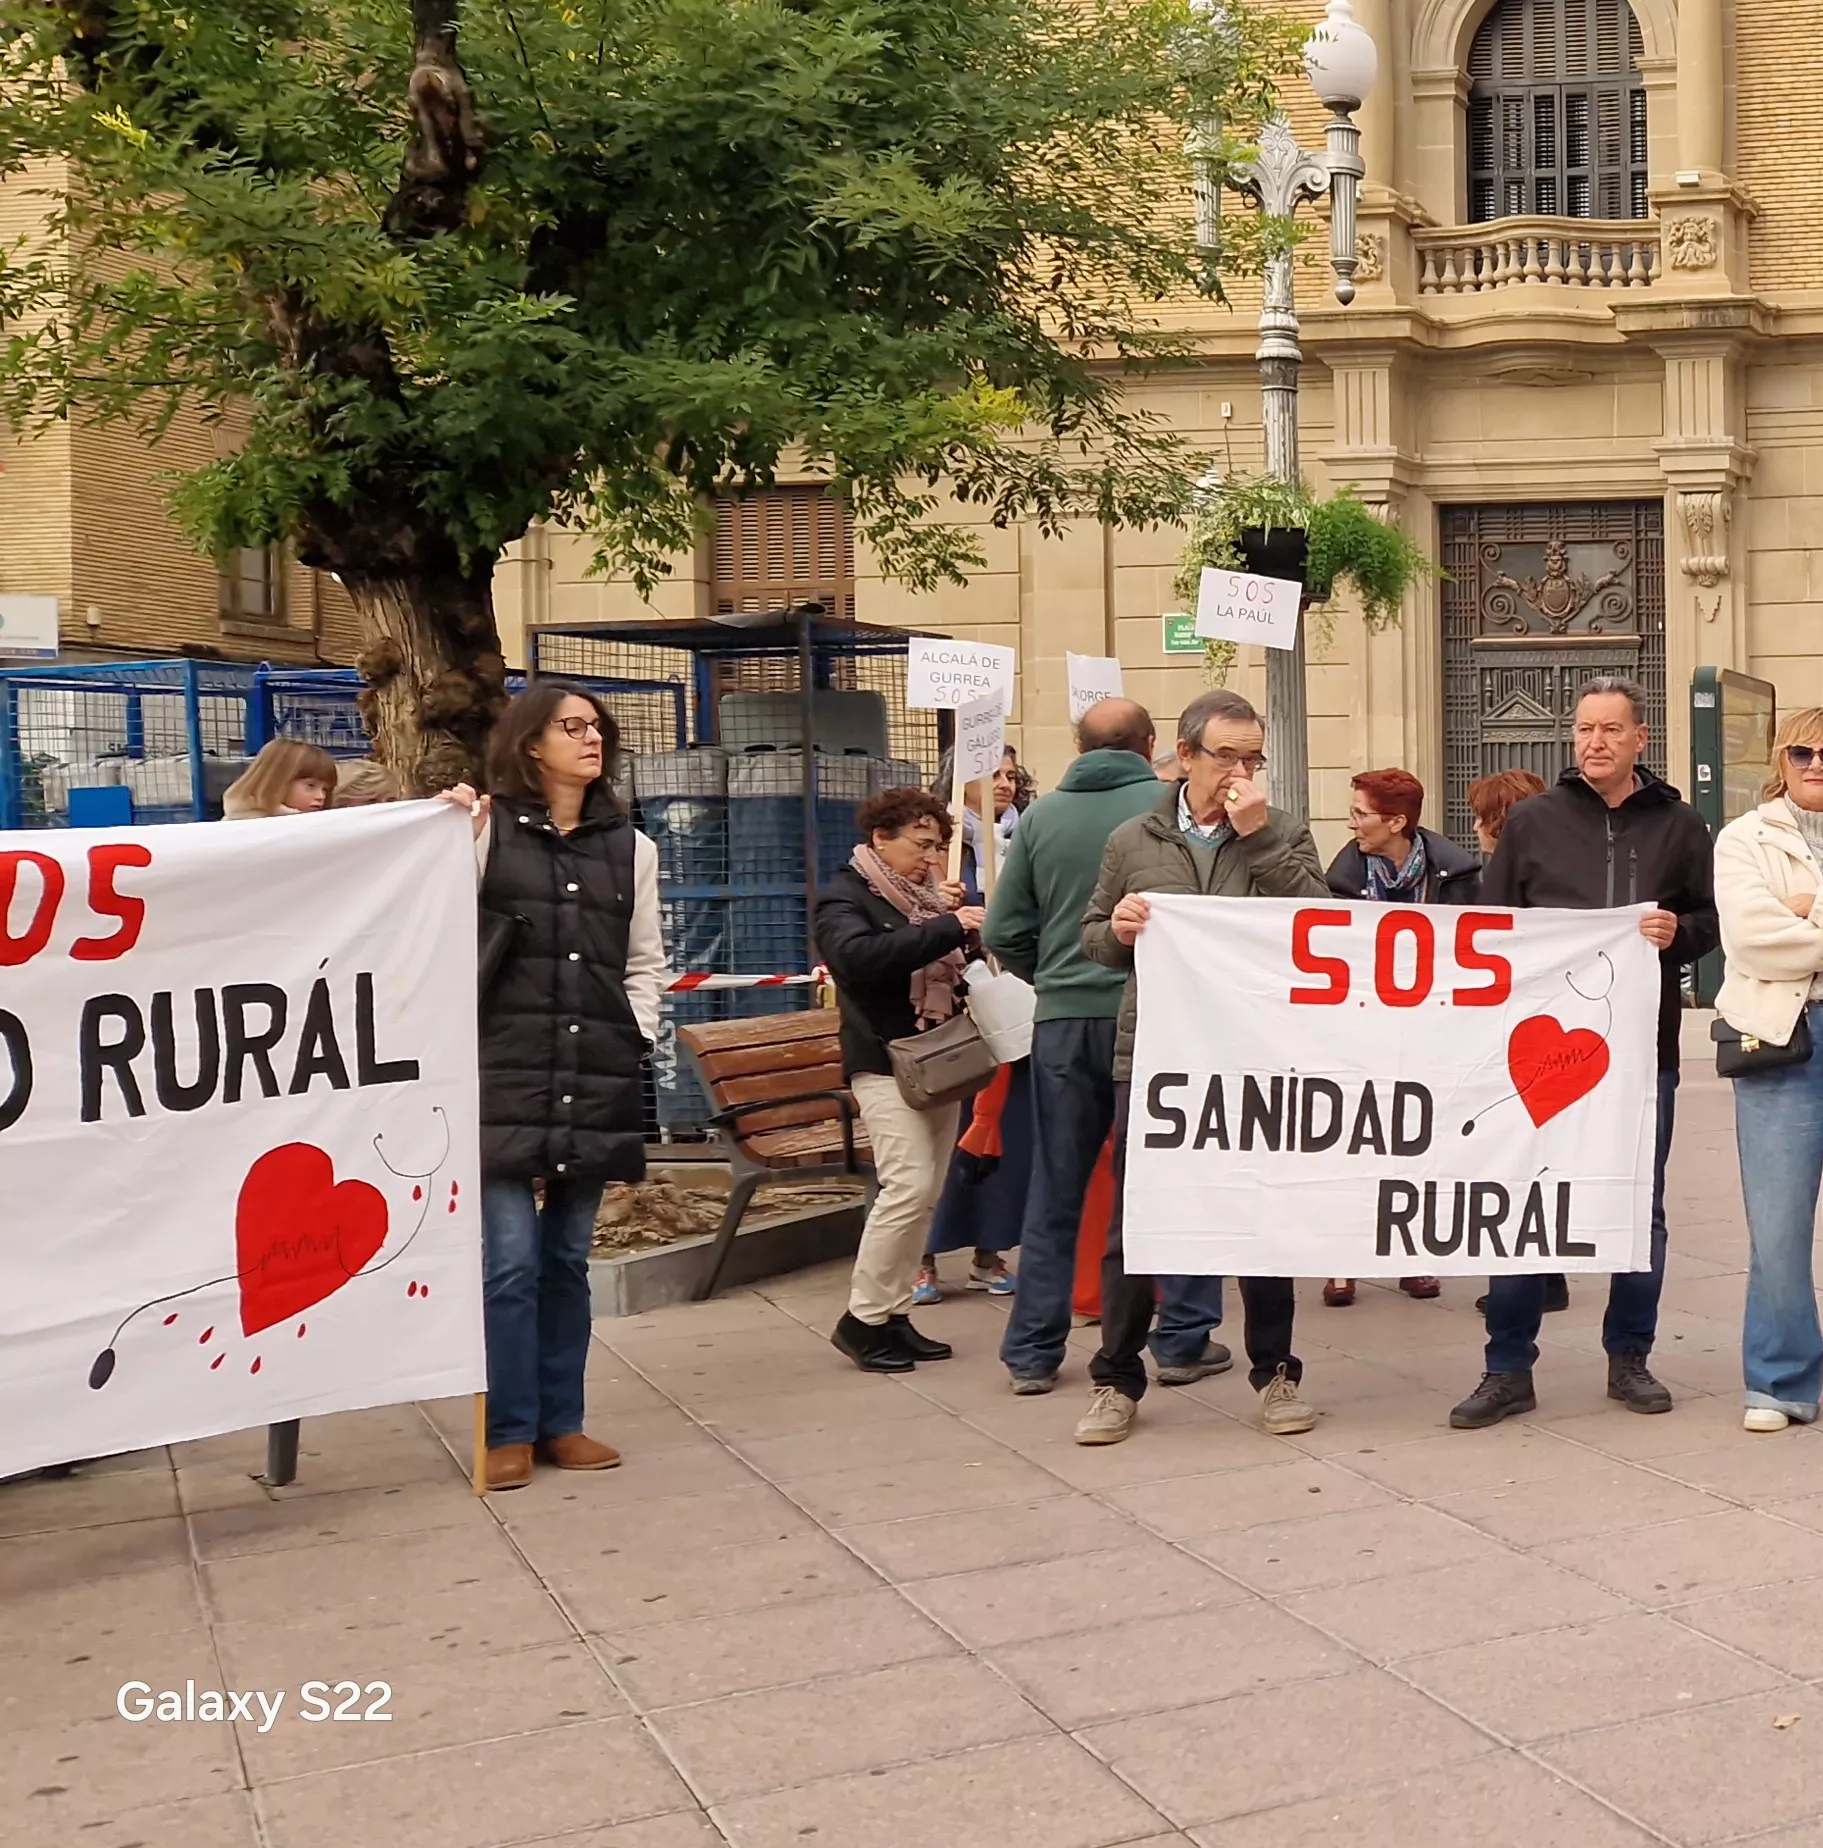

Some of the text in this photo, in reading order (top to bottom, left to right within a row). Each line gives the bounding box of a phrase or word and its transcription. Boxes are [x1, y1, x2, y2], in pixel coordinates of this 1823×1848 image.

[1227, 576, 1276, 604] SOS
[1216, 604, 1275, 625] LA PAÚL
[920, 651, 1001, 670] ALCALÁ DE
[929, 671, 991, 688] GURREA
[80, 957, 420, 1123] RURÁL
[1375, 1165, 1597, 1258] RURÁL
